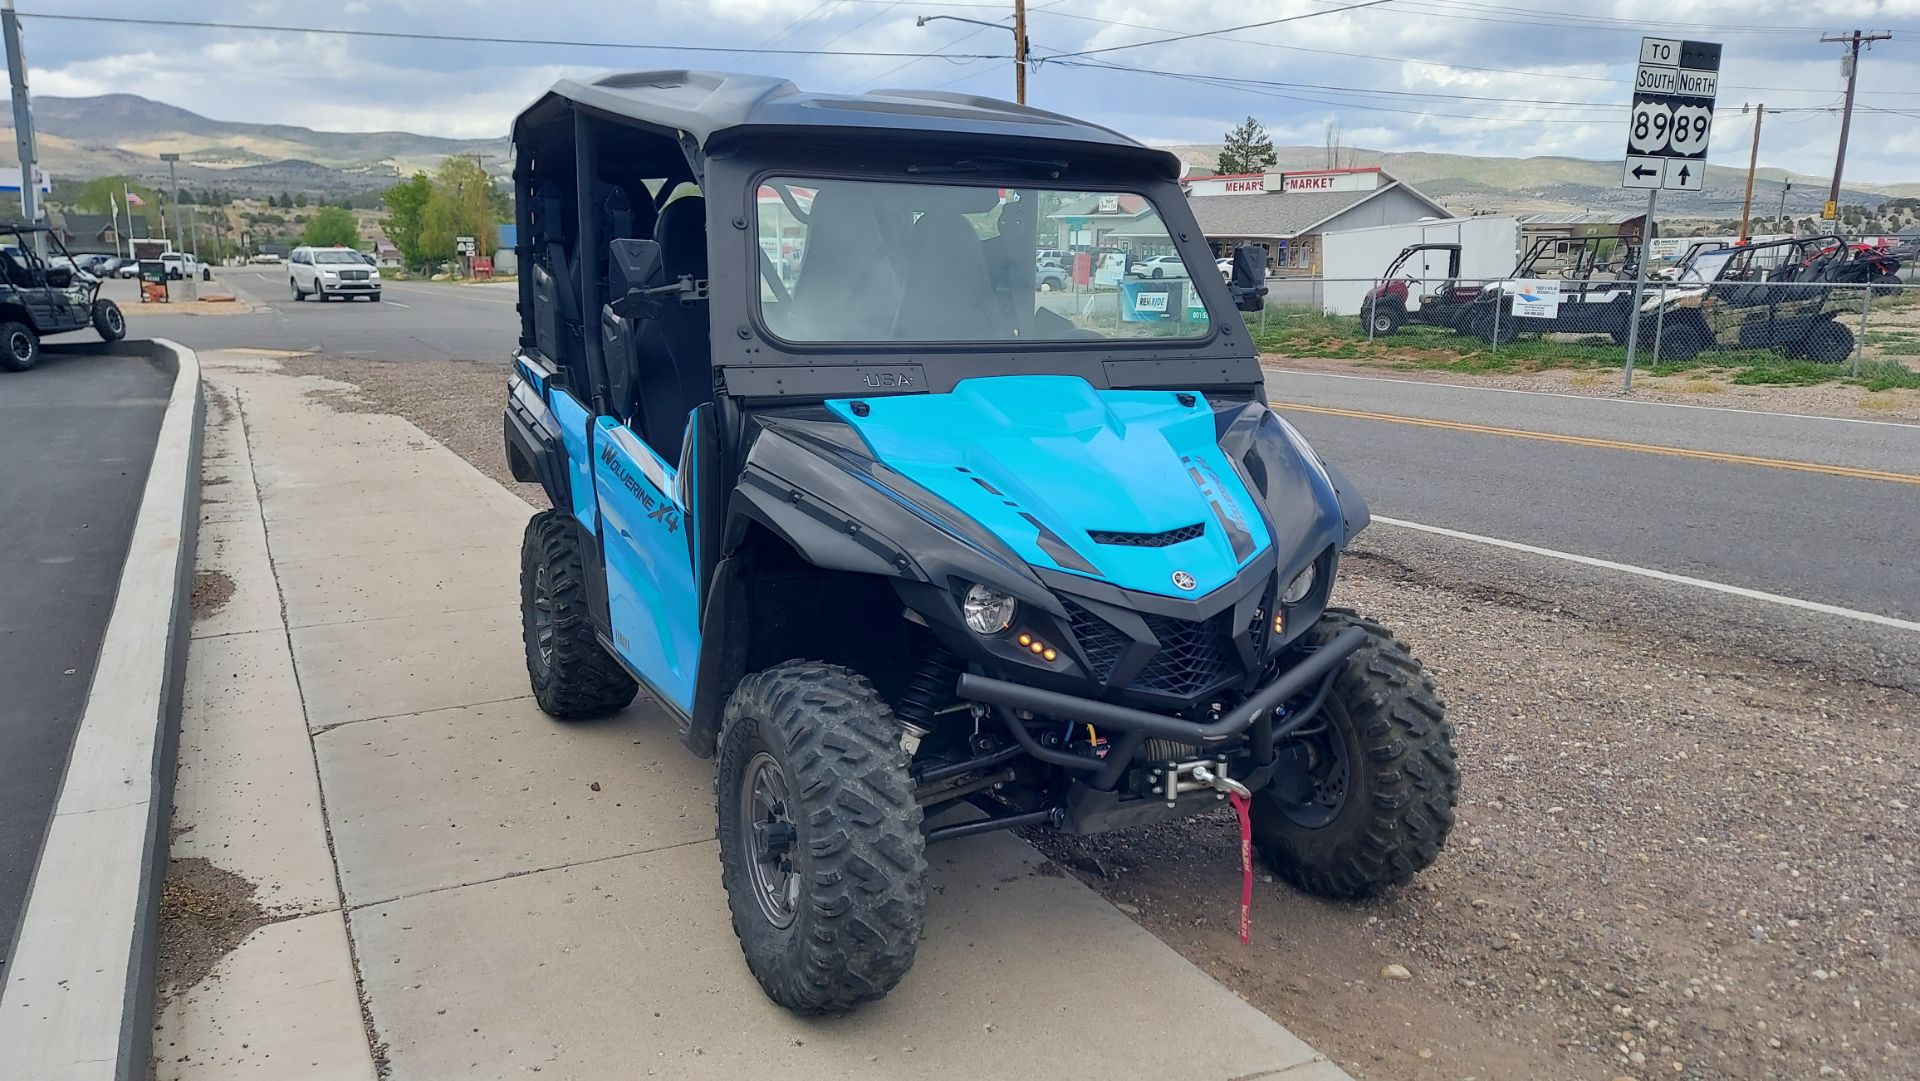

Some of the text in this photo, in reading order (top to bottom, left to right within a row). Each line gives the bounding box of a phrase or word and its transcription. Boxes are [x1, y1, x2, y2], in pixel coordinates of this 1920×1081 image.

[1652, 44, 1670, 60] TO
[1638, 70, 1675, 90] SOUTH
[1679, 74, 1715, 93] NORTH
[1634, 111, 1668, 140] 89
[1674, 115, 1707, 143] 89
[1225, 181, 1264, 192] MEHAR'S
[865, 373, 912, 387] USA
[600, 441, 679, 533] WOLVERINE X4
